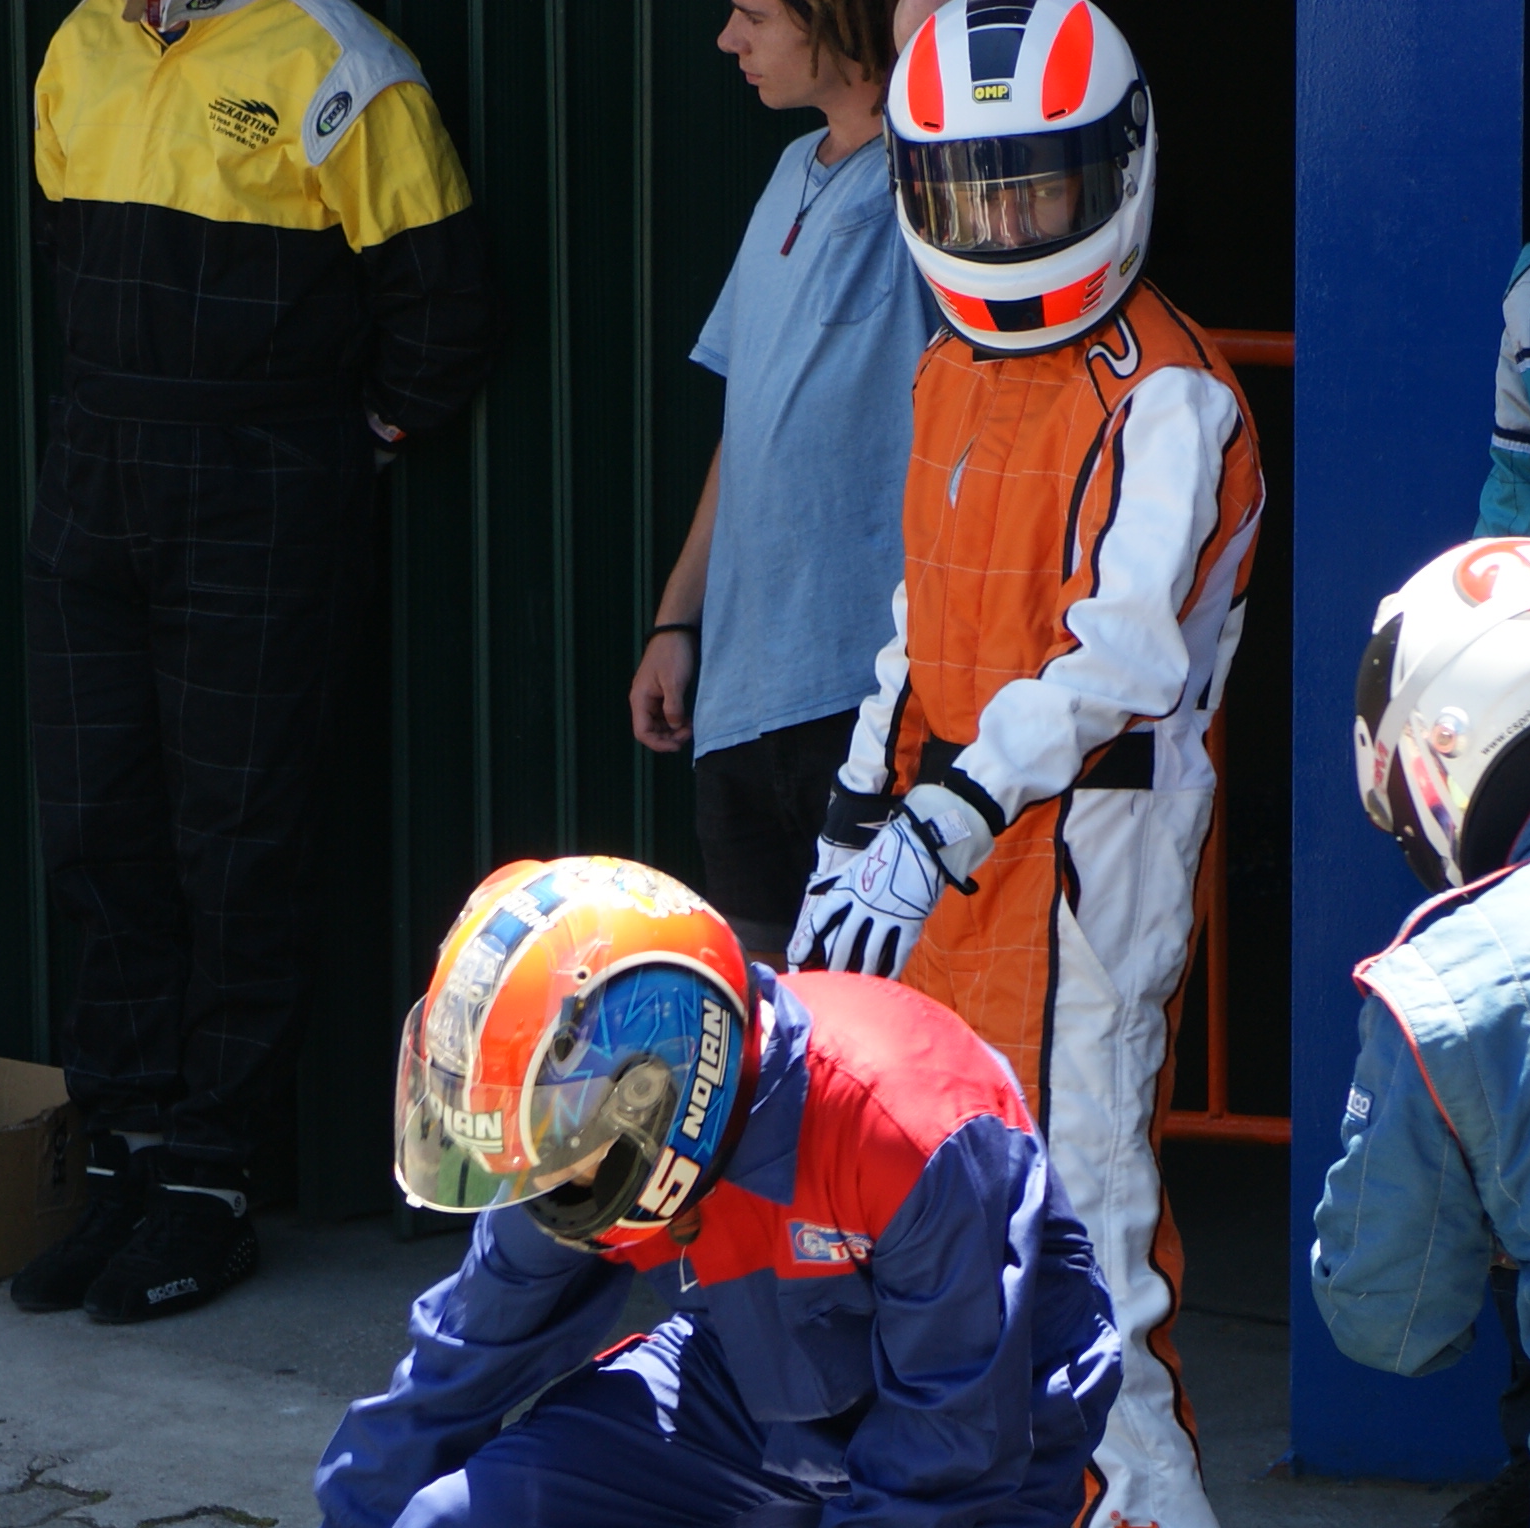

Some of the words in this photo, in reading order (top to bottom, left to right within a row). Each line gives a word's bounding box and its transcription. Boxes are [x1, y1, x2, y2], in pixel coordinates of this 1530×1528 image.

[227, 105, 278, 136] KARTING
[974, 85, 1009, 100] OMP
[682, 998, 730, 1140] NOLAN
[430, 1092, 503, 1153] OLAN
[638, 1146, 702, 1219] 5
